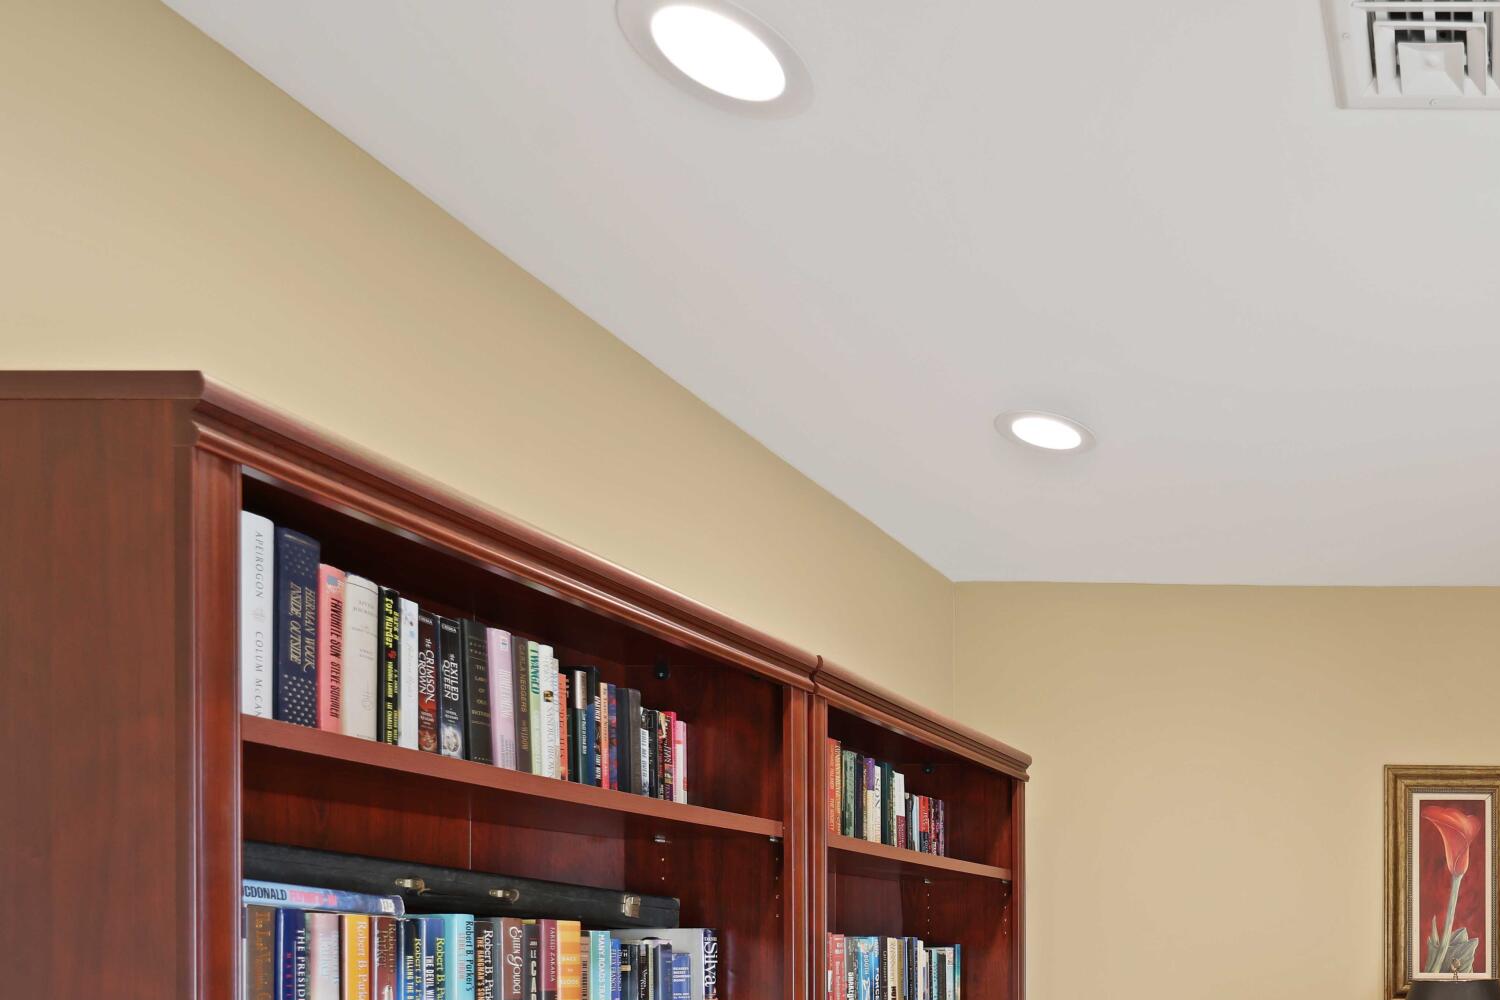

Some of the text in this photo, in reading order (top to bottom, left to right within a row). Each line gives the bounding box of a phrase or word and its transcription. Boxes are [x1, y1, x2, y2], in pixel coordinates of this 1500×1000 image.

[303, 586, 316, 673] HERMAN WOUK
[297, 928, 306, 952] THE
[484, 930, 495, 964] Robert
[598, 934, 606, 954] MANY
[485, 966, 495, 977] B.
[598, 957, 606, 983] ROADS
[703, 941, 720, 987] Silva
